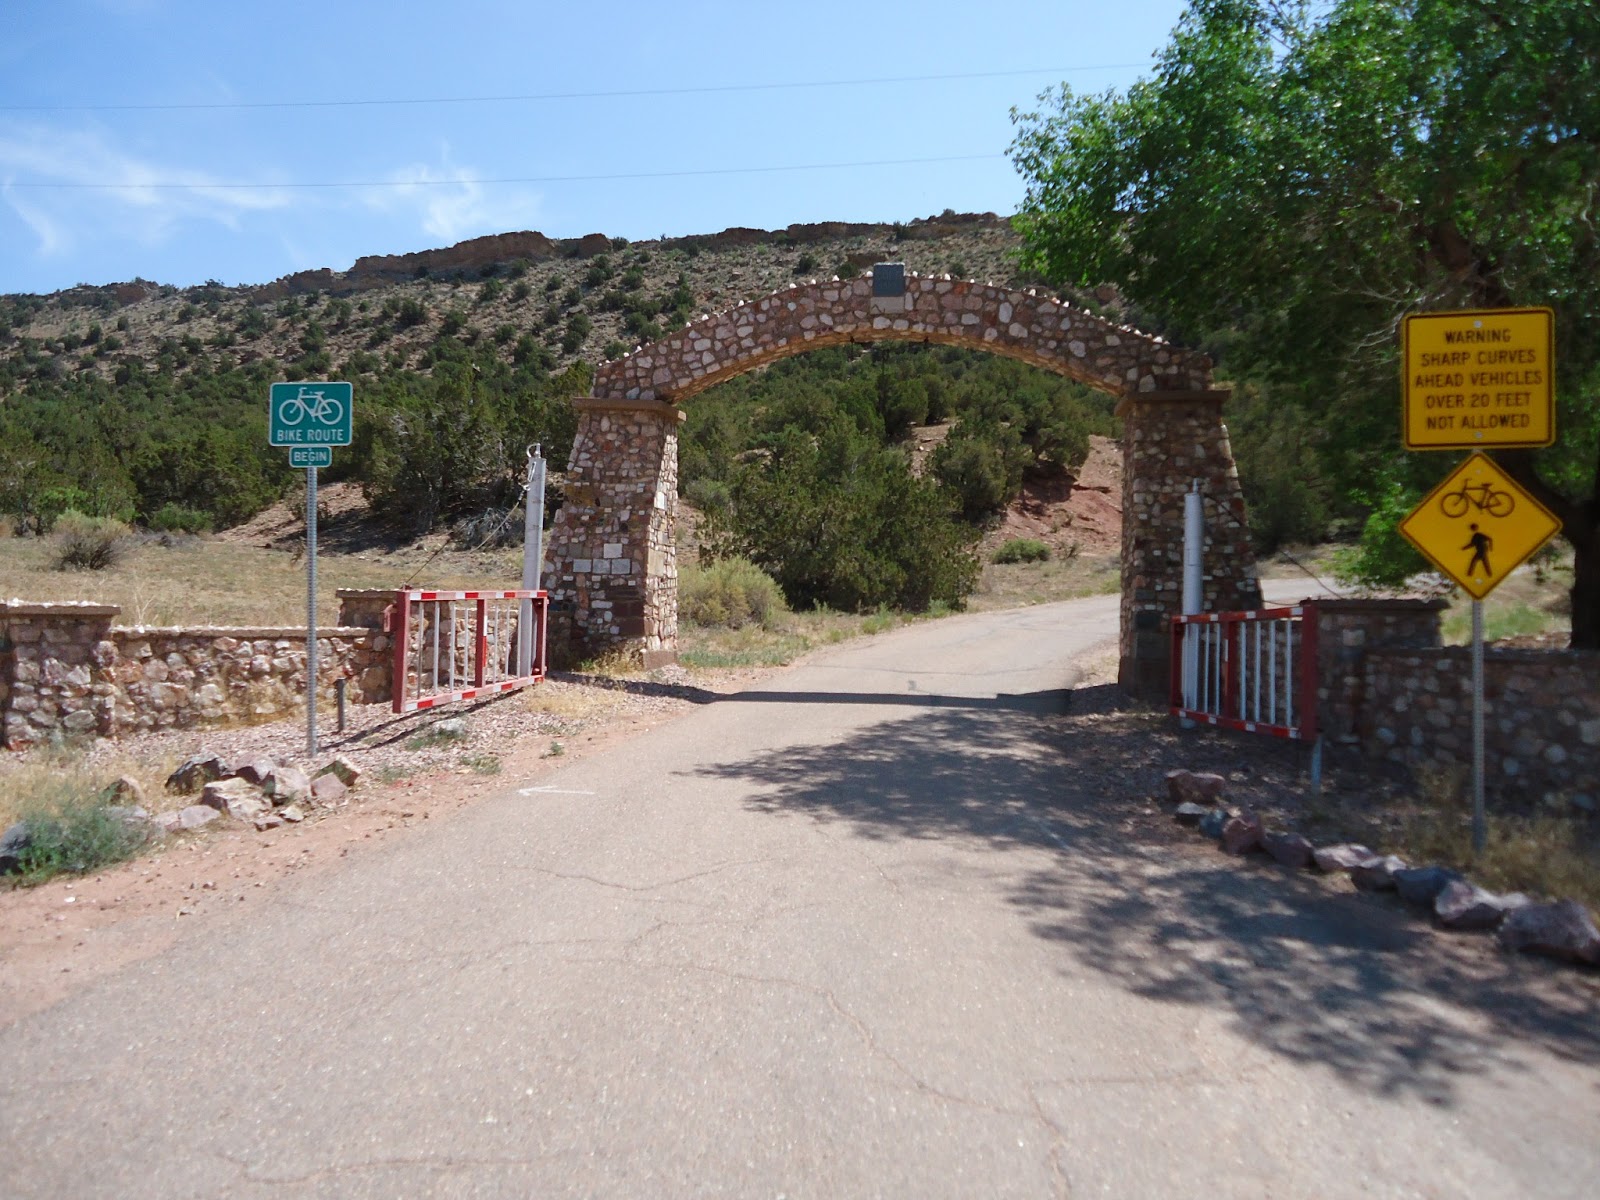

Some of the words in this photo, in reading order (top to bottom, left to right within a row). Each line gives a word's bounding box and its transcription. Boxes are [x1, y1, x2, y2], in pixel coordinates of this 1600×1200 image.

[1445, 329, 1511, 344] WARNING
[1421, 352, 1470, 367] SHARP
[1477, 349, 1536, 365] CURVES
[1415, 373, 1464, 388] AHEAD
[1470, 371, 1542, 386] VEHICLES
[1426, 395, 1464, 409] OVER
[1471, 393, 1490, 407] 20
[1497, 392, 1531, 407] FEET
[1427, 416, 1455, 430] NOT
[1461, 414, 1530, 429] ALLOWED
[277, 430, 303, 441] BIKE
[307, 429, 344, 441] ROUTE
[293, 451, 327, 462] BEGIN
